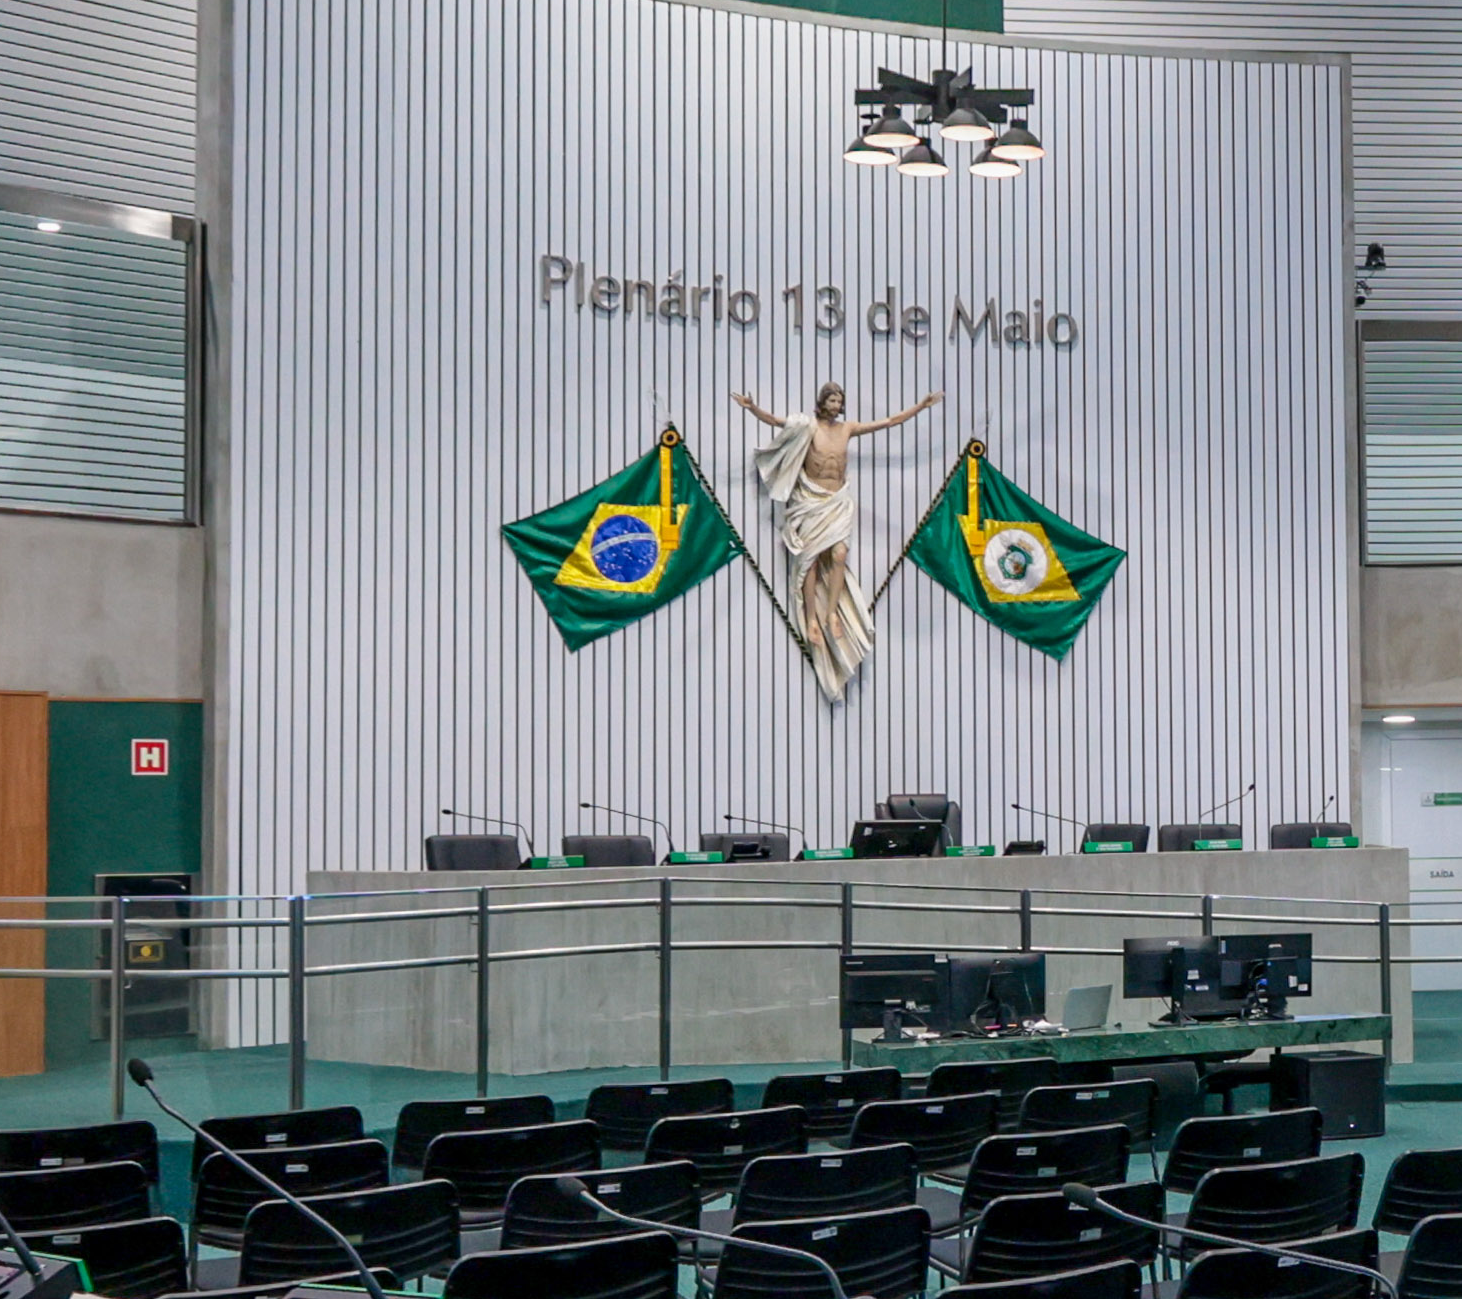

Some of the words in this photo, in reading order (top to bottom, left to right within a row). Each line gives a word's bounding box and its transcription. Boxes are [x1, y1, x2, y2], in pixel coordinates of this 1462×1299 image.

[540, 254, 760, 326] Plenário
[782, 283, 845, 334] 13
[867, 286, 930, 340] de
[948, 294, 1080, 348] Maio
[139, 746, 160, 768] H
